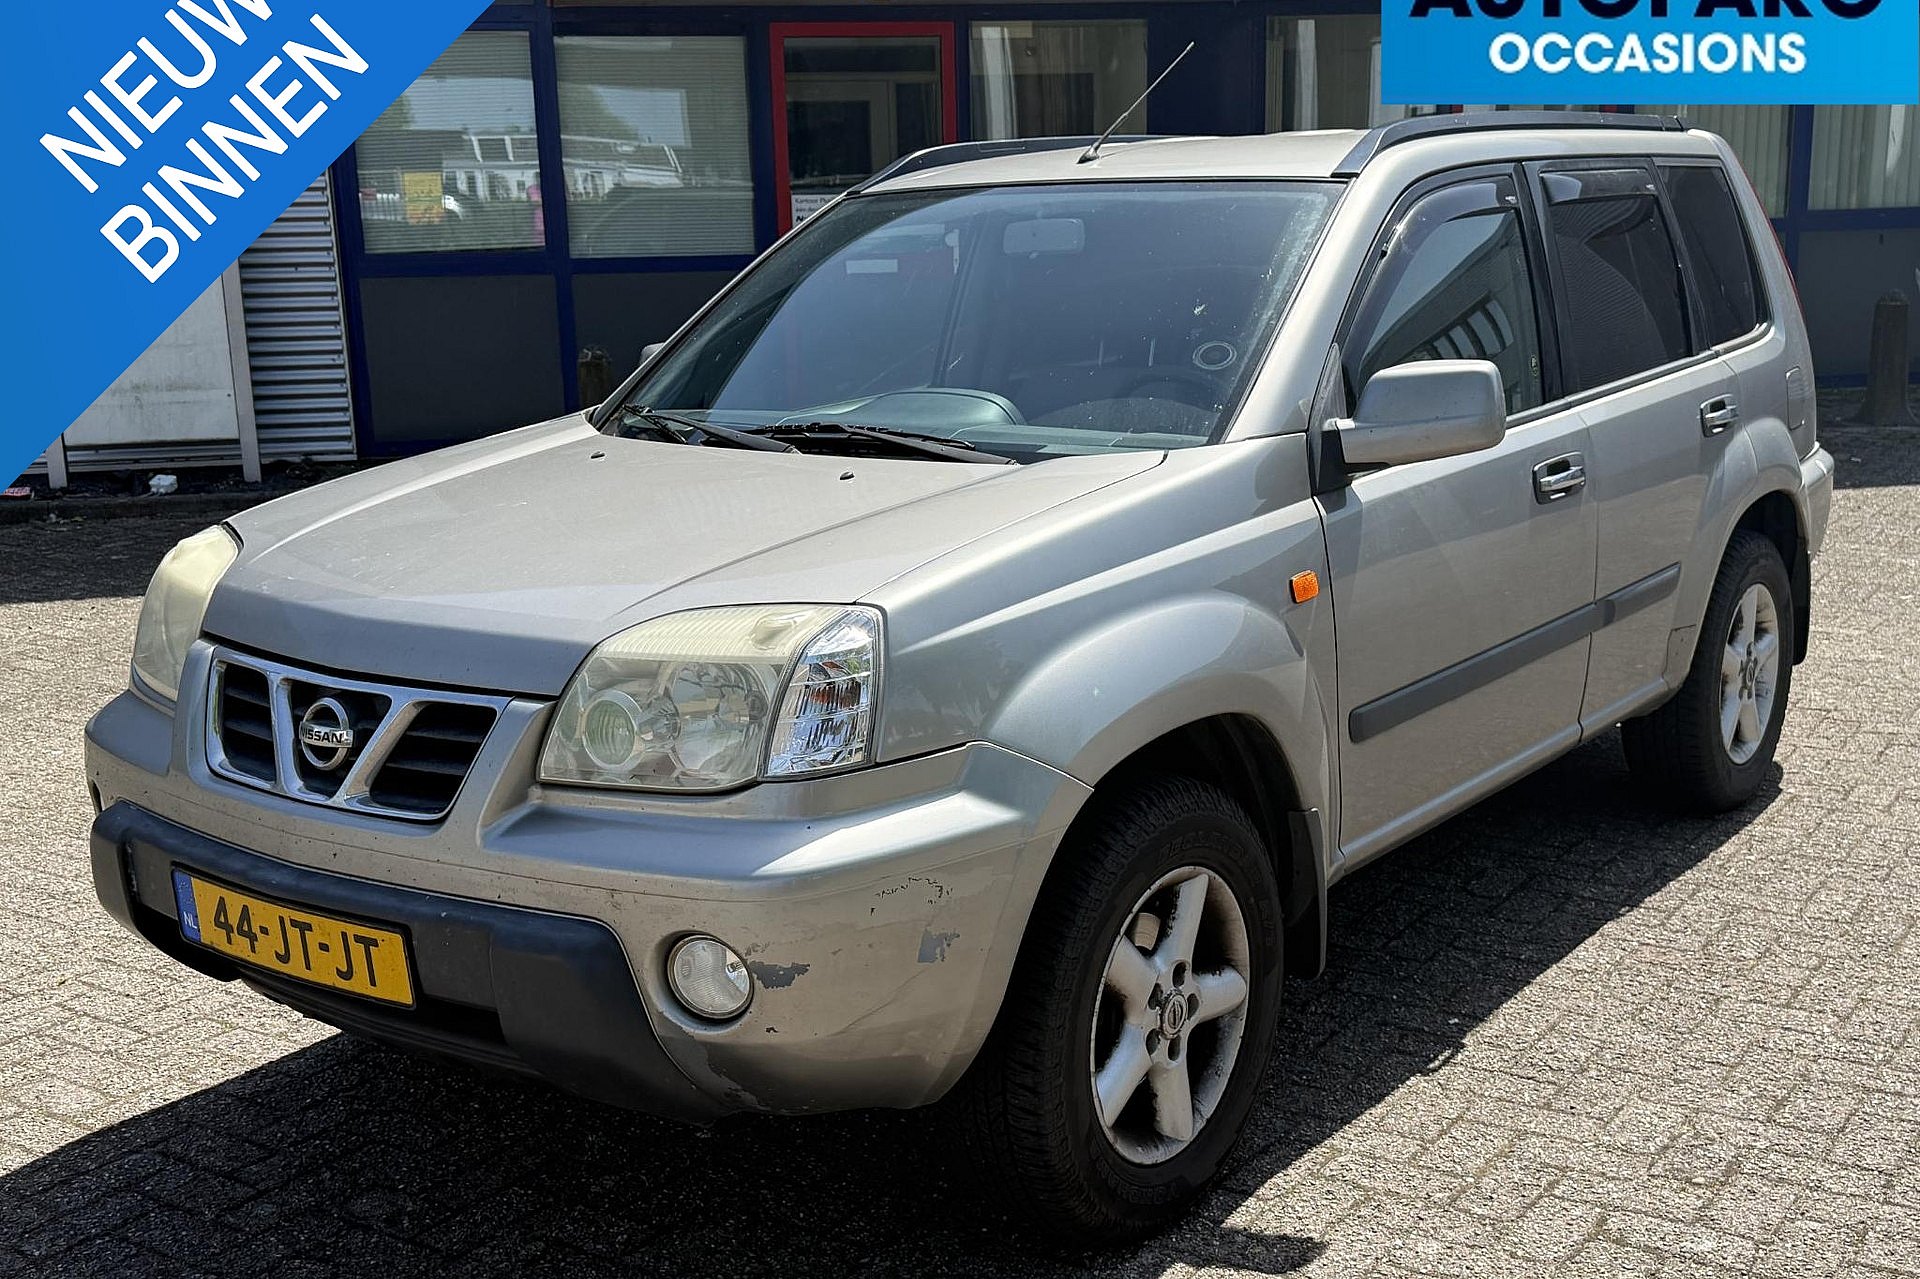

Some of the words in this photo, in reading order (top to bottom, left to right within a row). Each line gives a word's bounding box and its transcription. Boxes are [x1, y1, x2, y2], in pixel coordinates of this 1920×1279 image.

[301, 725, 342, 743] NISSAN
[184, 911, 197, 929] NL
[213, 895, 379, 987] 44-JT-JT
